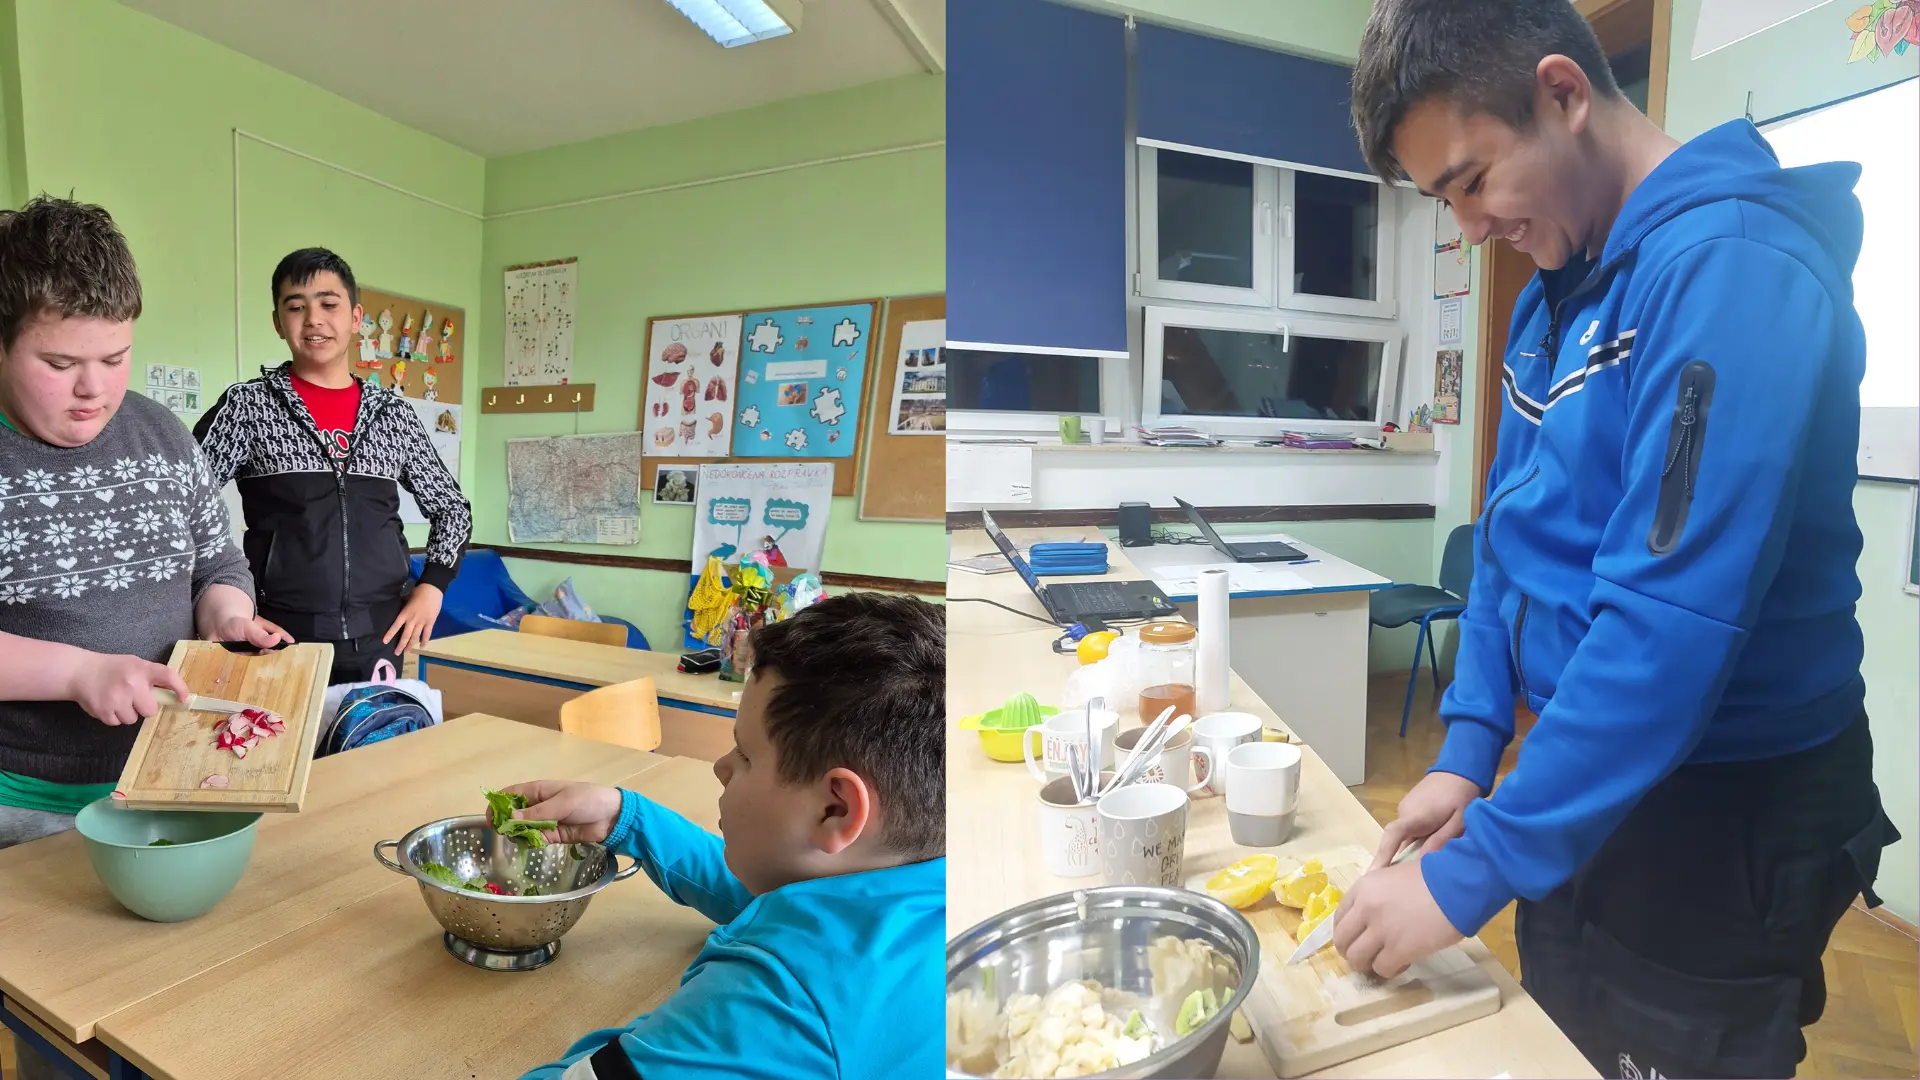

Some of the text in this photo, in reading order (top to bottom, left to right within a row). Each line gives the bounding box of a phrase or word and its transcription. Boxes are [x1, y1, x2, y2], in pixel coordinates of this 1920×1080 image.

[670, 319, 727, 341] ORGANI
[1047, 739, 1088, 763] ENJY
[1143, 842, 1162, 858] WE
